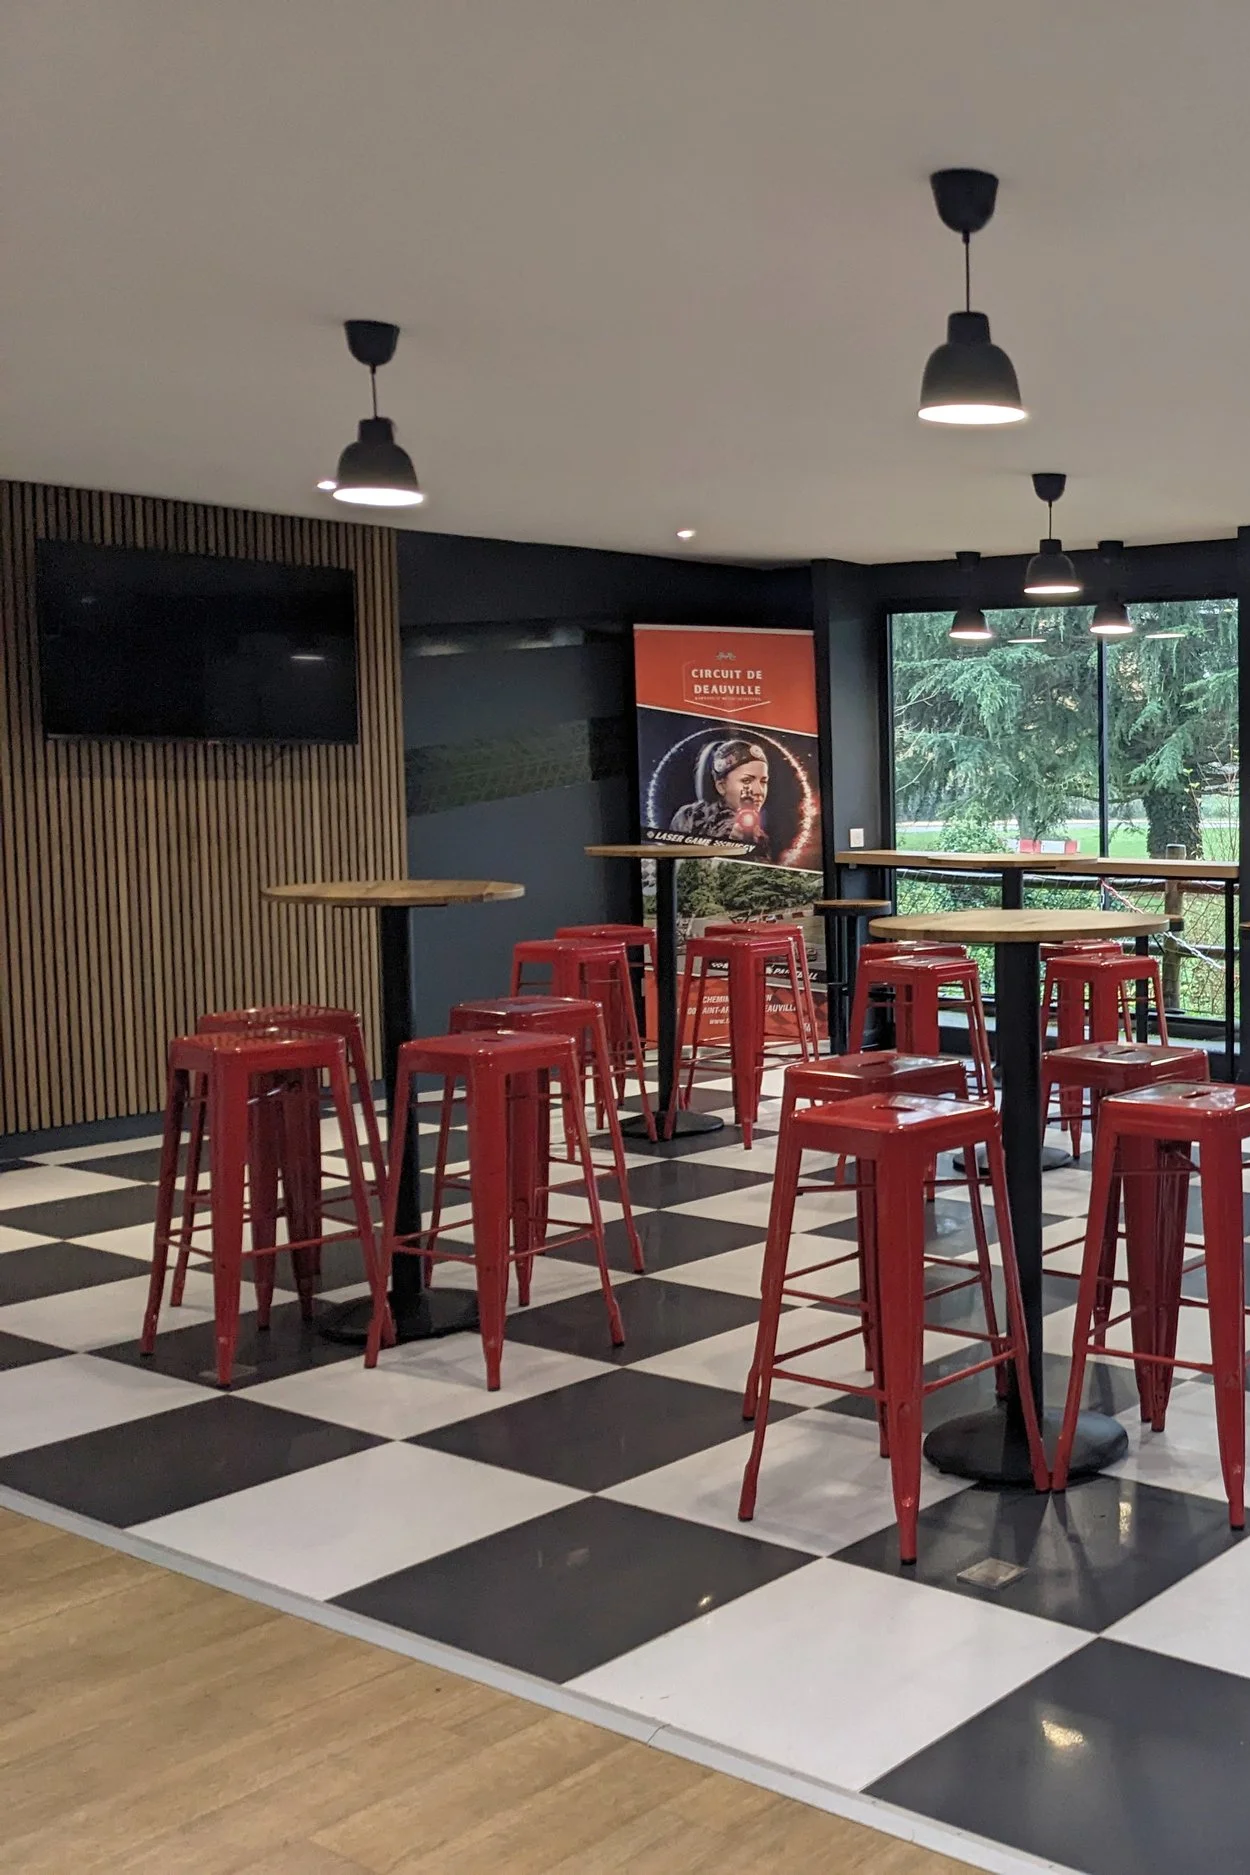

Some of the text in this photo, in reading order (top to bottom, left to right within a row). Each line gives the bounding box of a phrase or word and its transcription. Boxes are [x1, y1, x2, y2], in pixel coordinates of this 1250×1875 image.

[691, 668, 763, 680] CIRCUIT DE
[693, 684, 761, 695] DEAUVILLE
[655, 832, 685, 843] LASER
[684, 836, 713, 847] GAME
